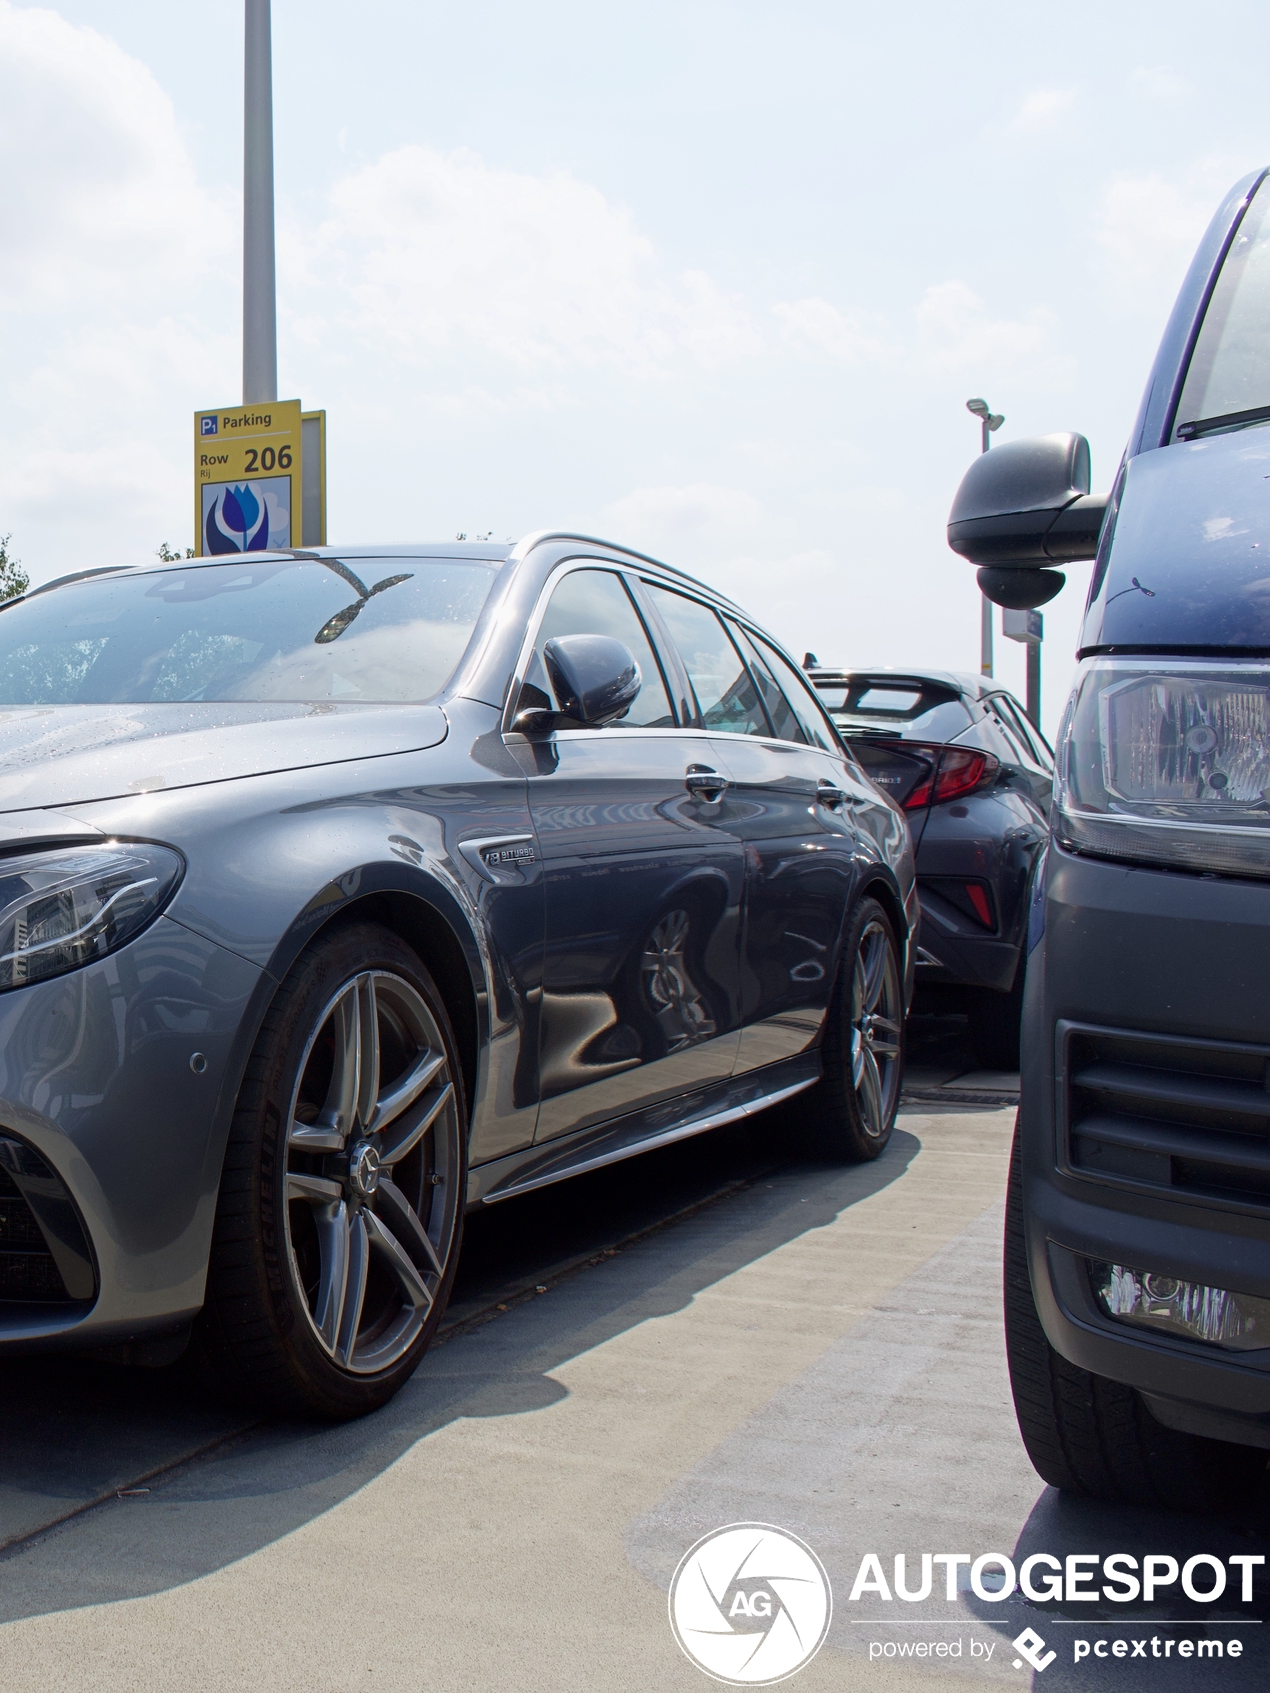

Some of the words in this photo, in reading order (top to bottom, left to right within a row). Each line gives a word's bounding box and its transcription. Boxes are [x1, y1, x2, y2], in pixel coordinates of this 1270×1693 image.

[223, 413, 272, 429] Parking
[200, 454, 229, 466] Row
[244, 445, 293, 473] 206
[200, 469, 211, 479] Rij
[502, 848, 534, 859] BITURBO
[260, 1112, 283, 1292] MICHELIN
